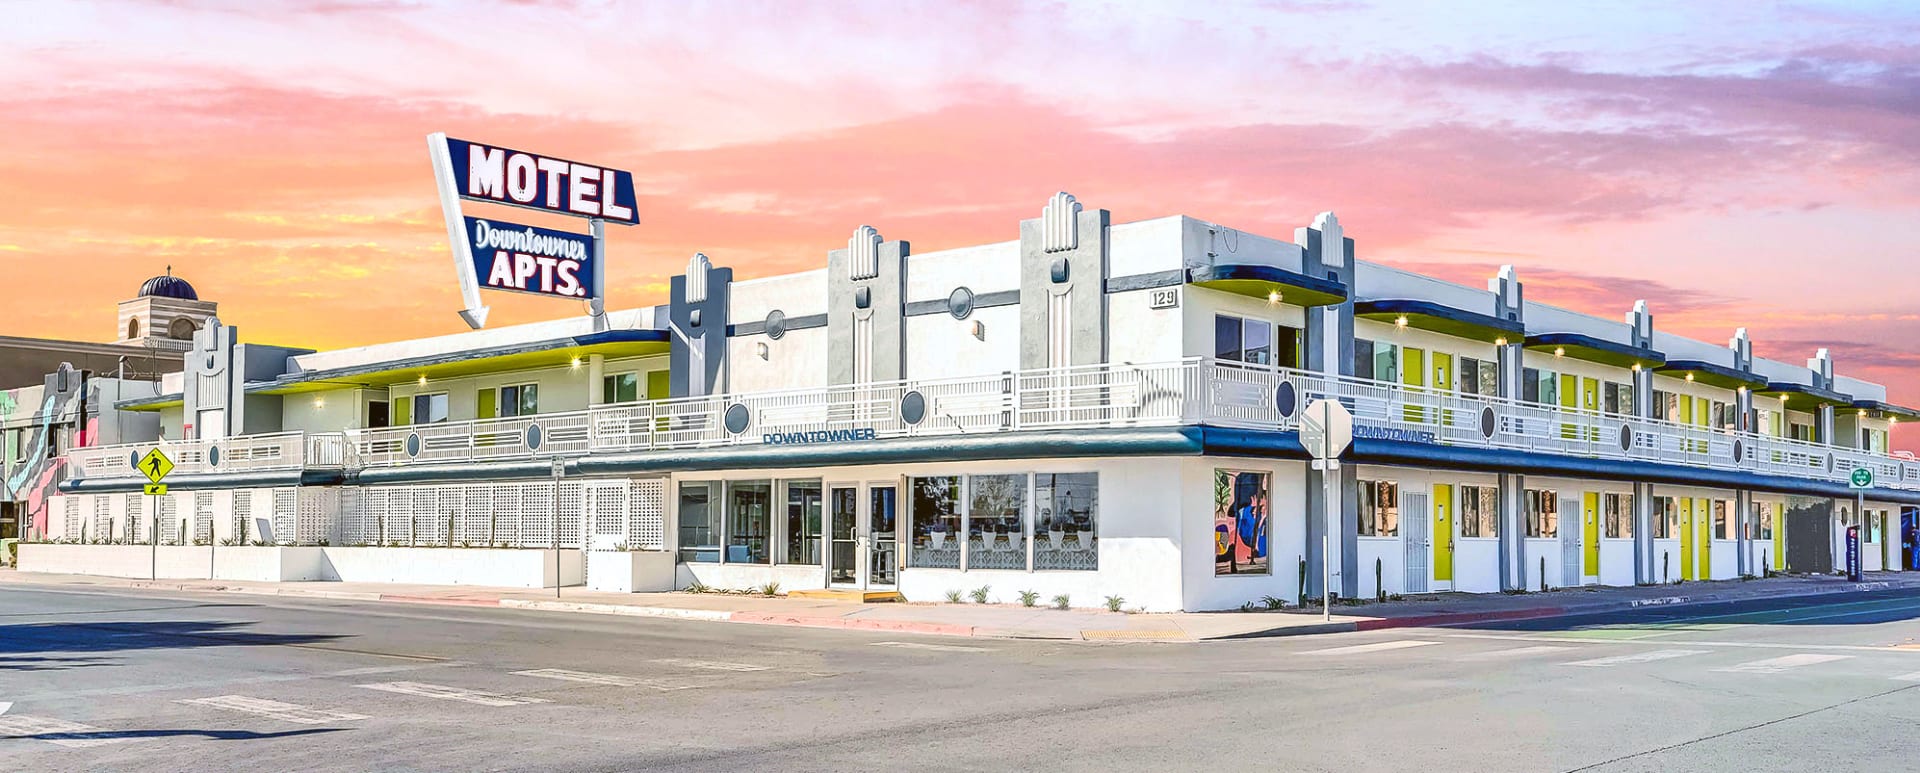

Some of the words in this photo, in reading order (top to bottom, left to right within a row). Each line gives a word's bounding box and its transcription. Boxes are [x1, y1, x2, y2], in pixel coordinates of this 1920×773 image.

[468, 144, 633, 220] MOTEL
[475, 219, 587, 261] Downtowner
[488, 250, 586, 297] APTS.
[1153, 291, 1174, 306] 129
[763, 428, 876, 445] DOWNTOWNER
